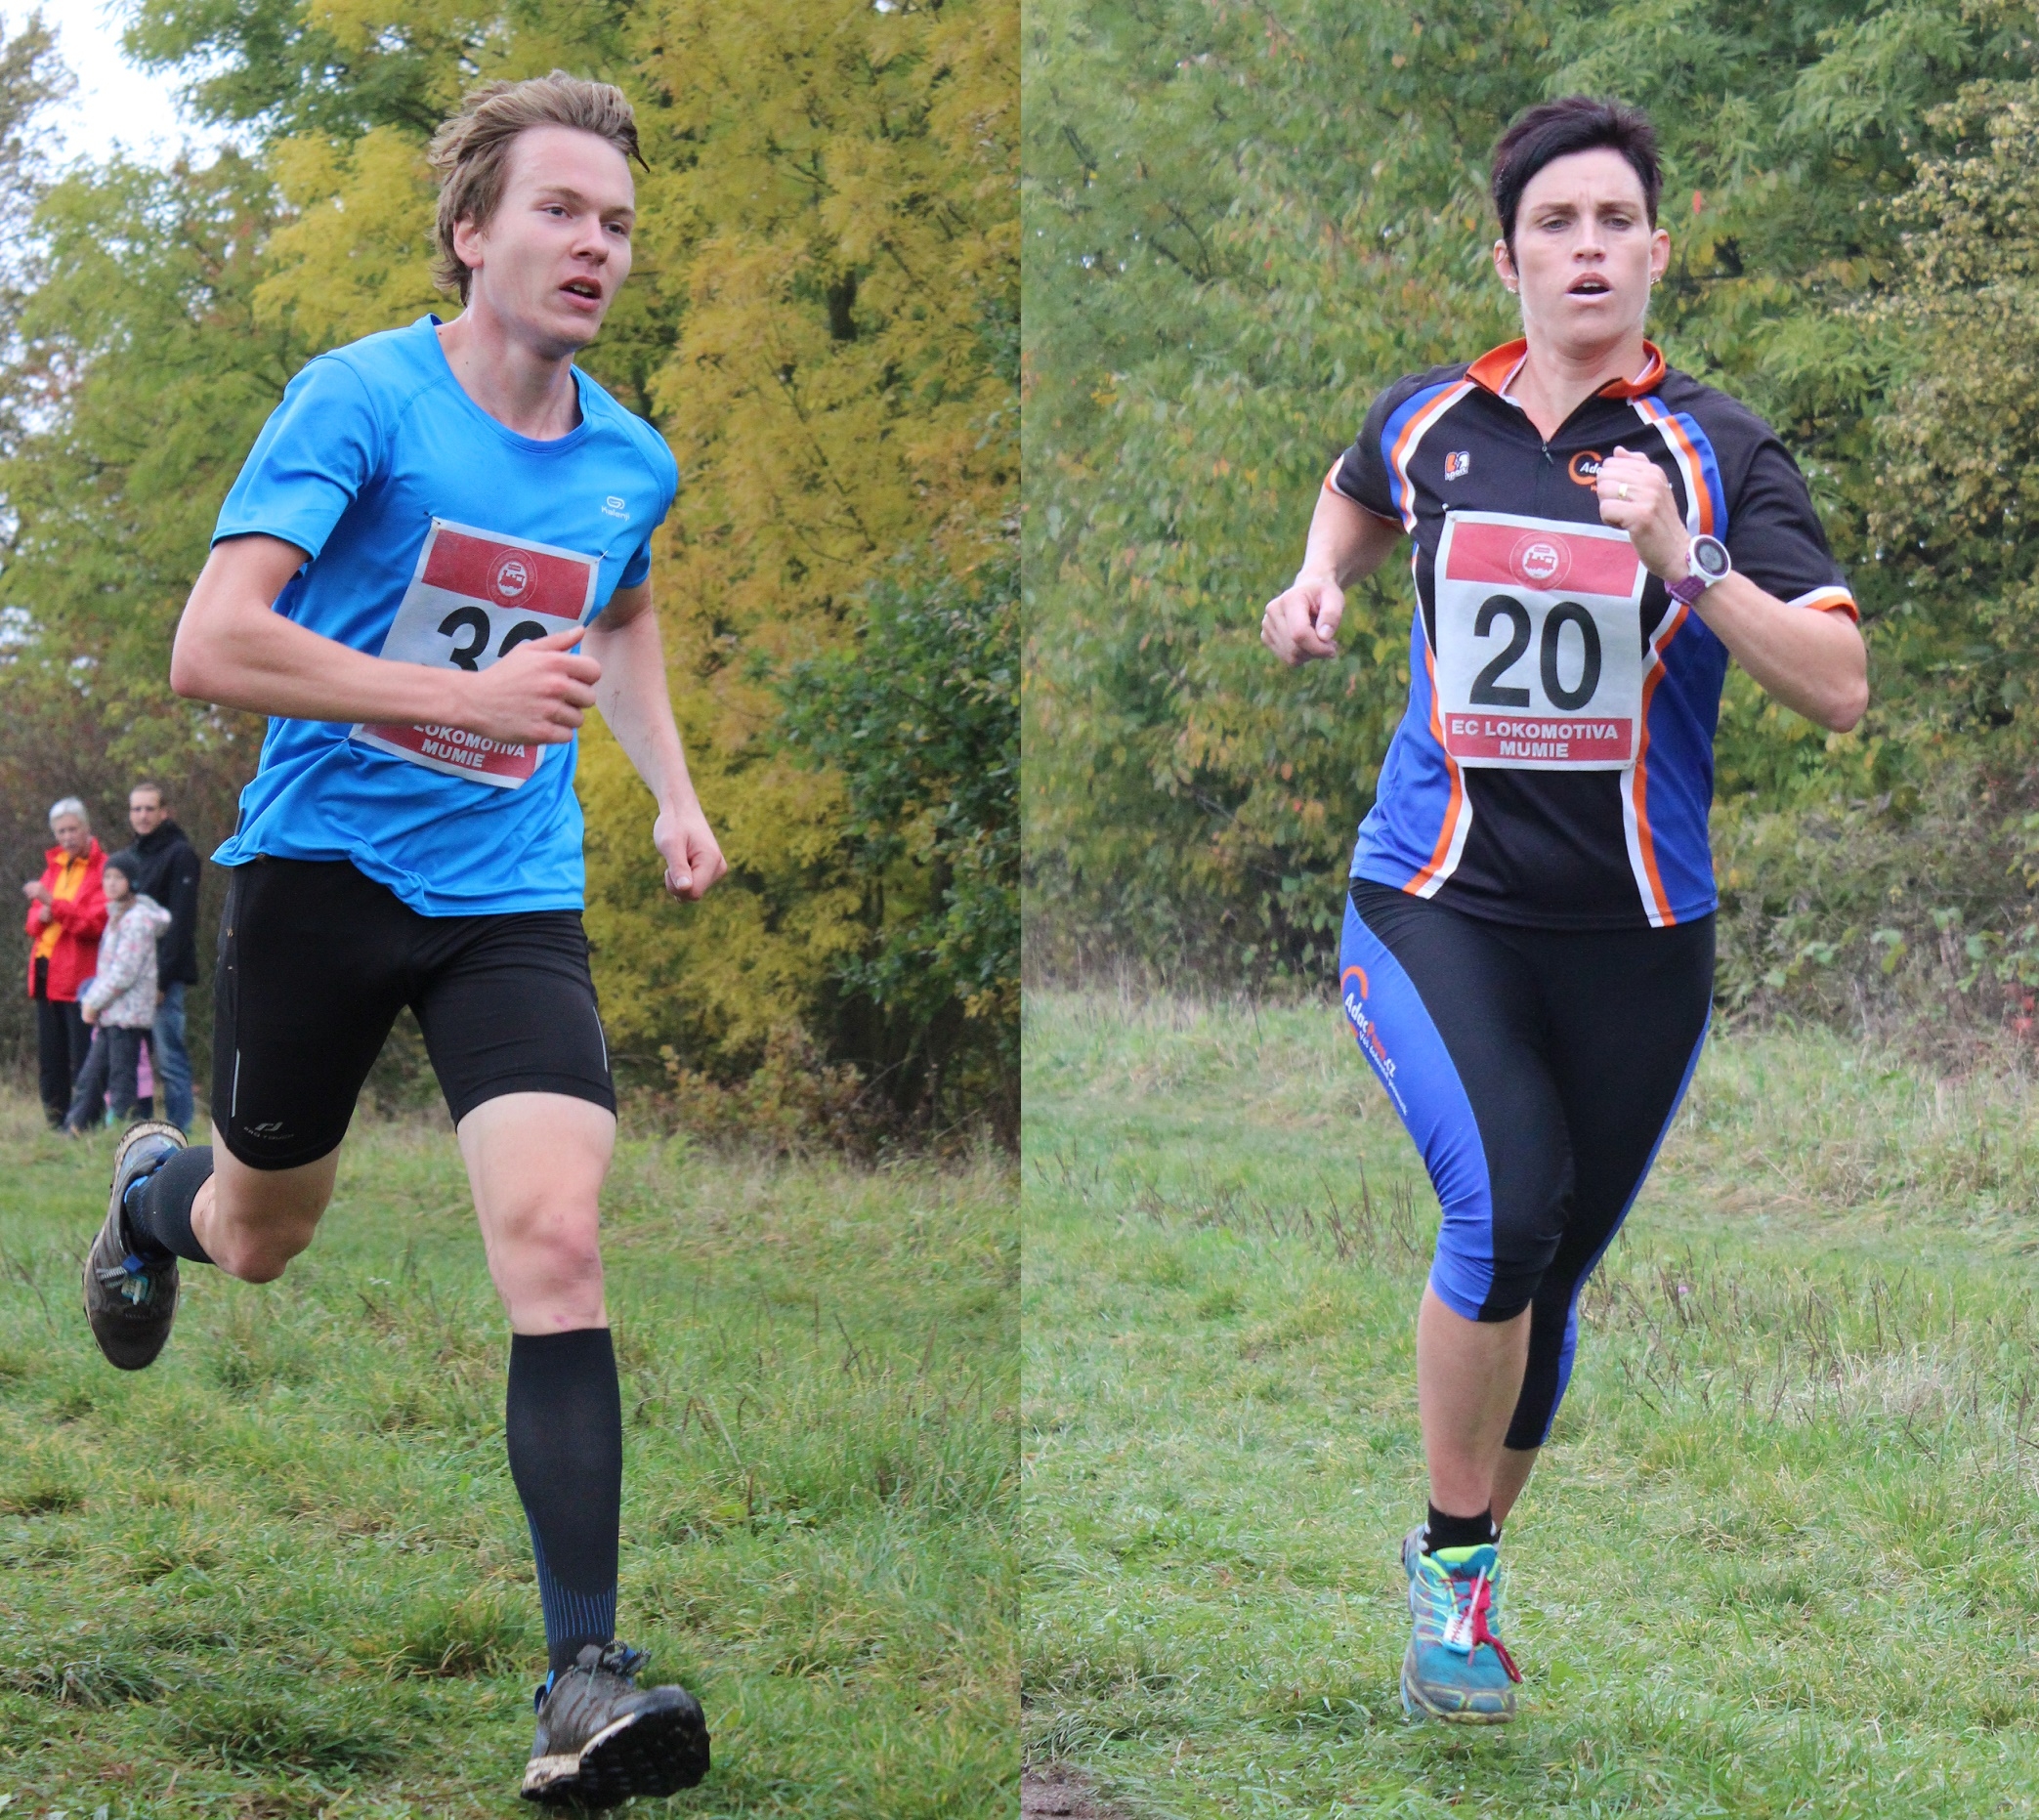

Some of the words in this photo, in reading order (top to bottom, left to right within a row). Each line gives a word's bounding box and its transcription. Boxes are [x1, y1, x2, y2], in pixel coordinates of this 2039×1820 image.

[601, 505, 630, 522] Kalenji
[1468, 594, 1602, 711] 20
[1451, 719, 1479, 737] EC
[1484, 720, 1619, 740] LOKOMOTIVA
[421, 739, 486, 768] MUMIE
[1500, 741, 1569, 758] MUMIE
